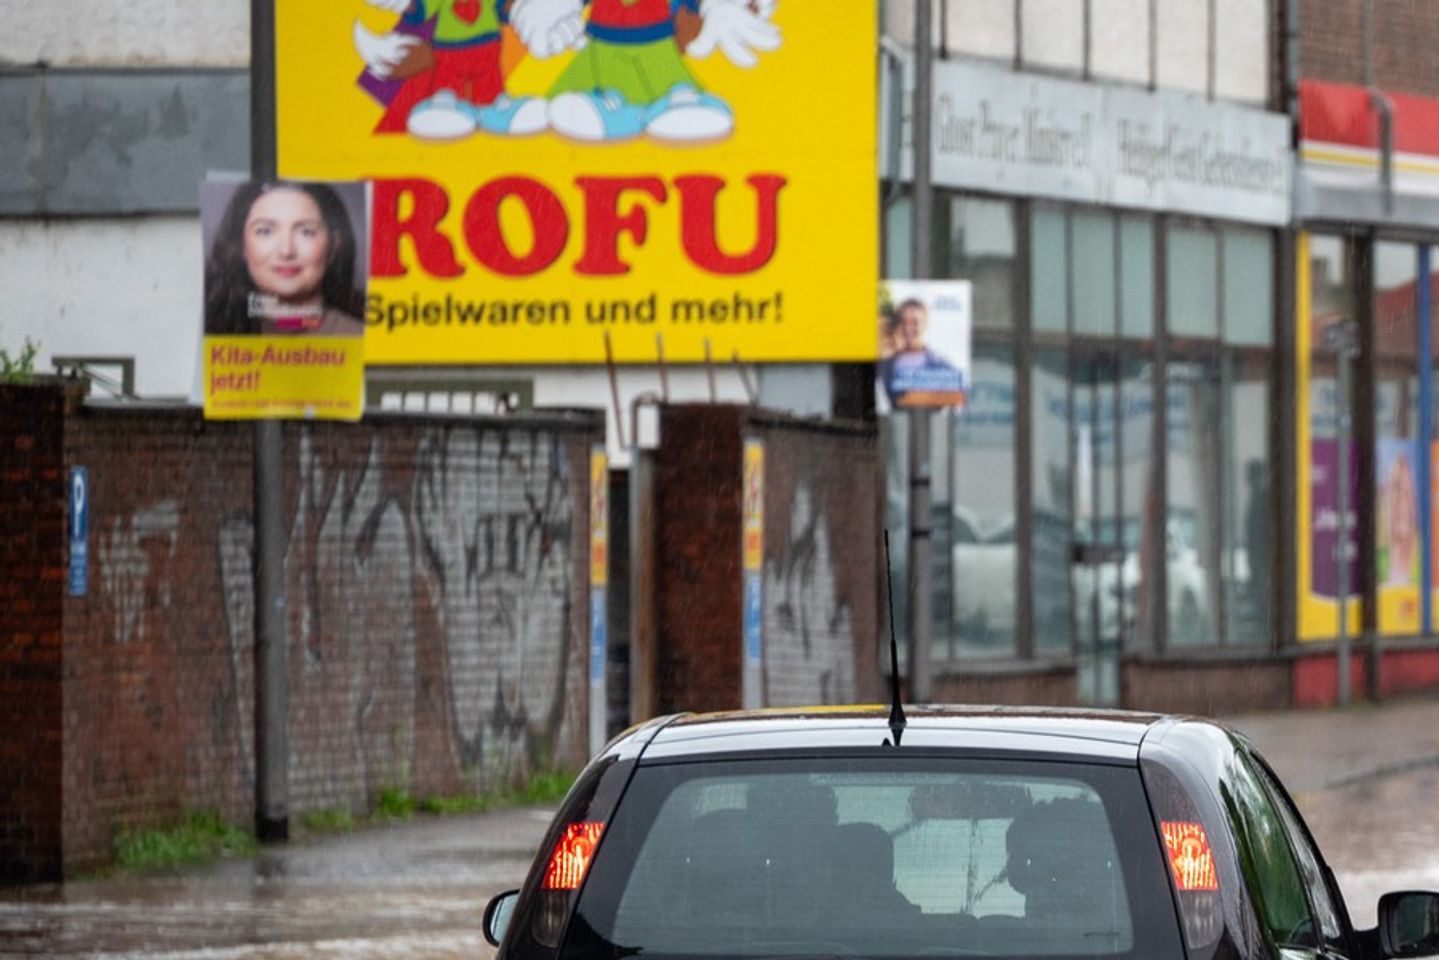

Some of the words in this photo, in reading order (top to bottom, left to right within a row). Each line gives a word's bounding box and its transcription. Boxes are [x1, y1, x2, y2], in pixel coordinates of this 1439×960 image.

[369, 174, 788, 279] ROFU
[363, 293, 571, 331] Spielwaren
[585, 293, 657, 323] und
[671, 292, 783, 323] mehr!
[211, 345, 346, 366] Kita-Ausbau
[211, 371, 260, 396] jetzt!
